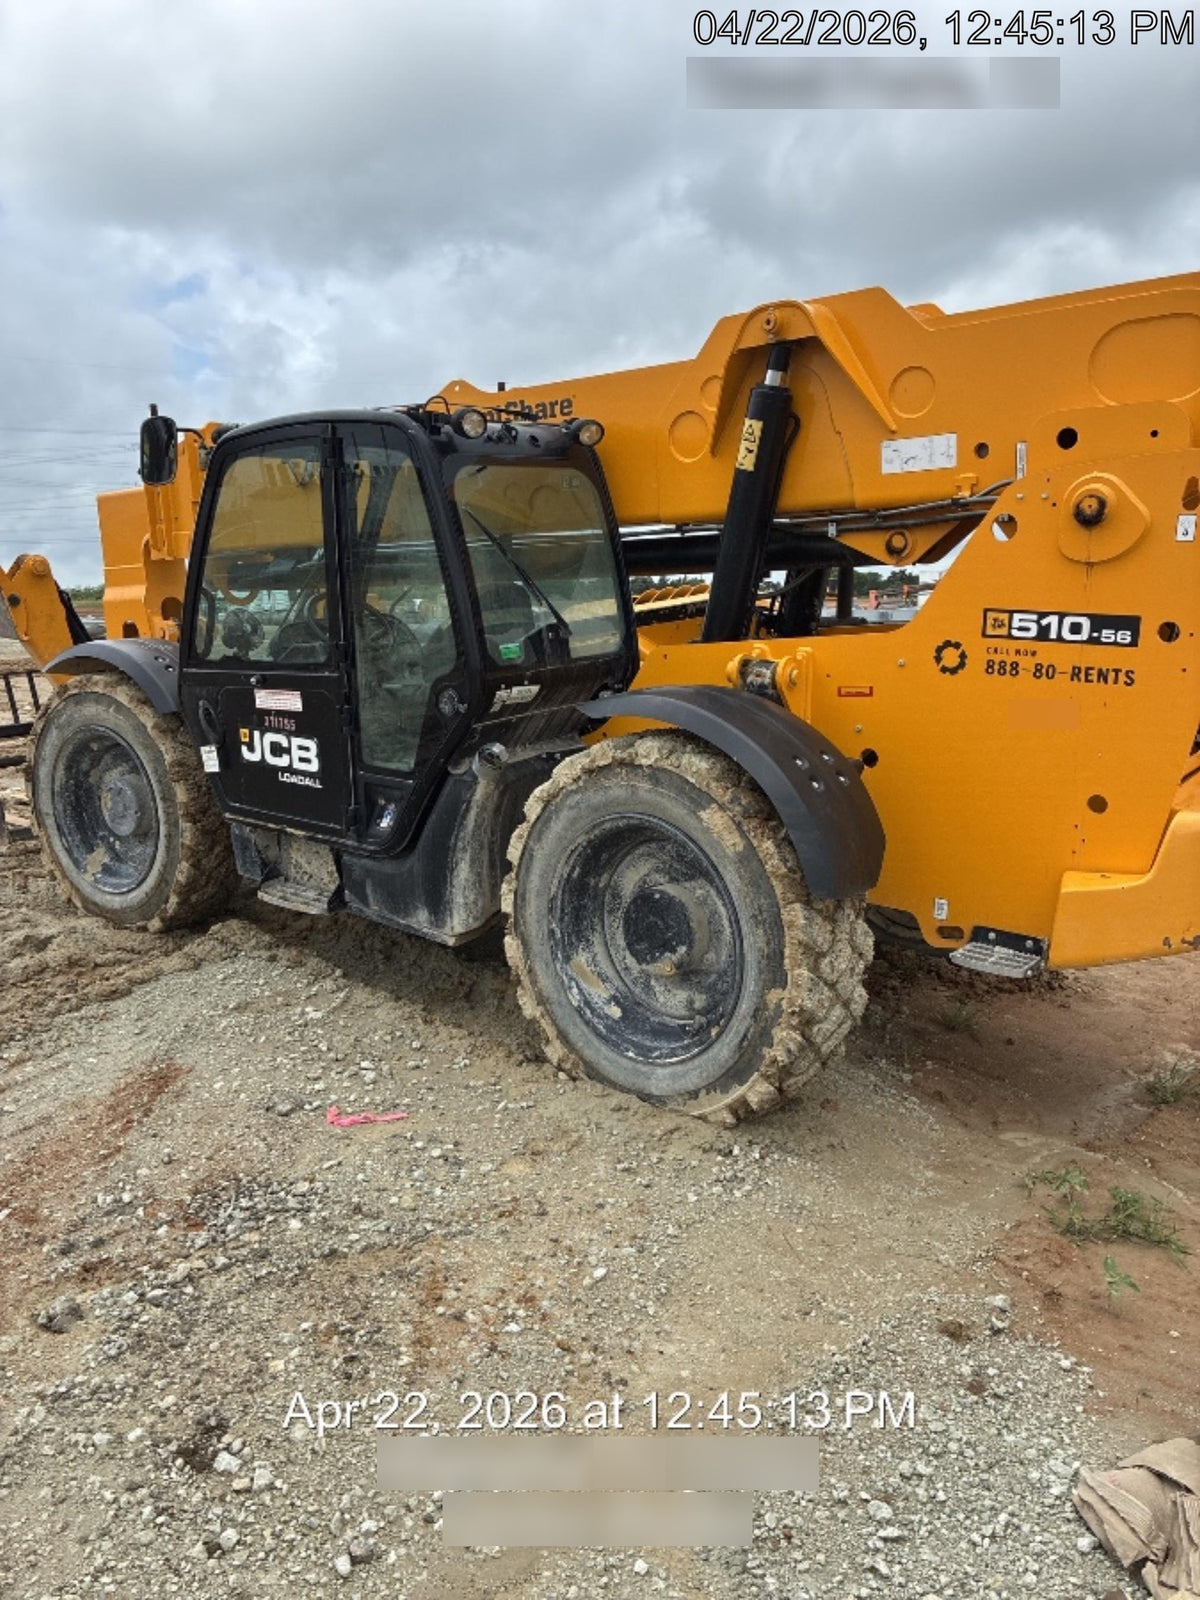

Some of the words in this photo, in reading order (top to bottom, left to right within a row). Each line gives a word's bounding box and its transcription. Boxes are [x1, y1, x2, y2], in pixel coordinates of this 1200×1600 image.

[1011, 612, 1132, 643] 510-56
[985, 659, 1136, 687] 888-80-RENTS
[240, 729, 319, 772] JCB
